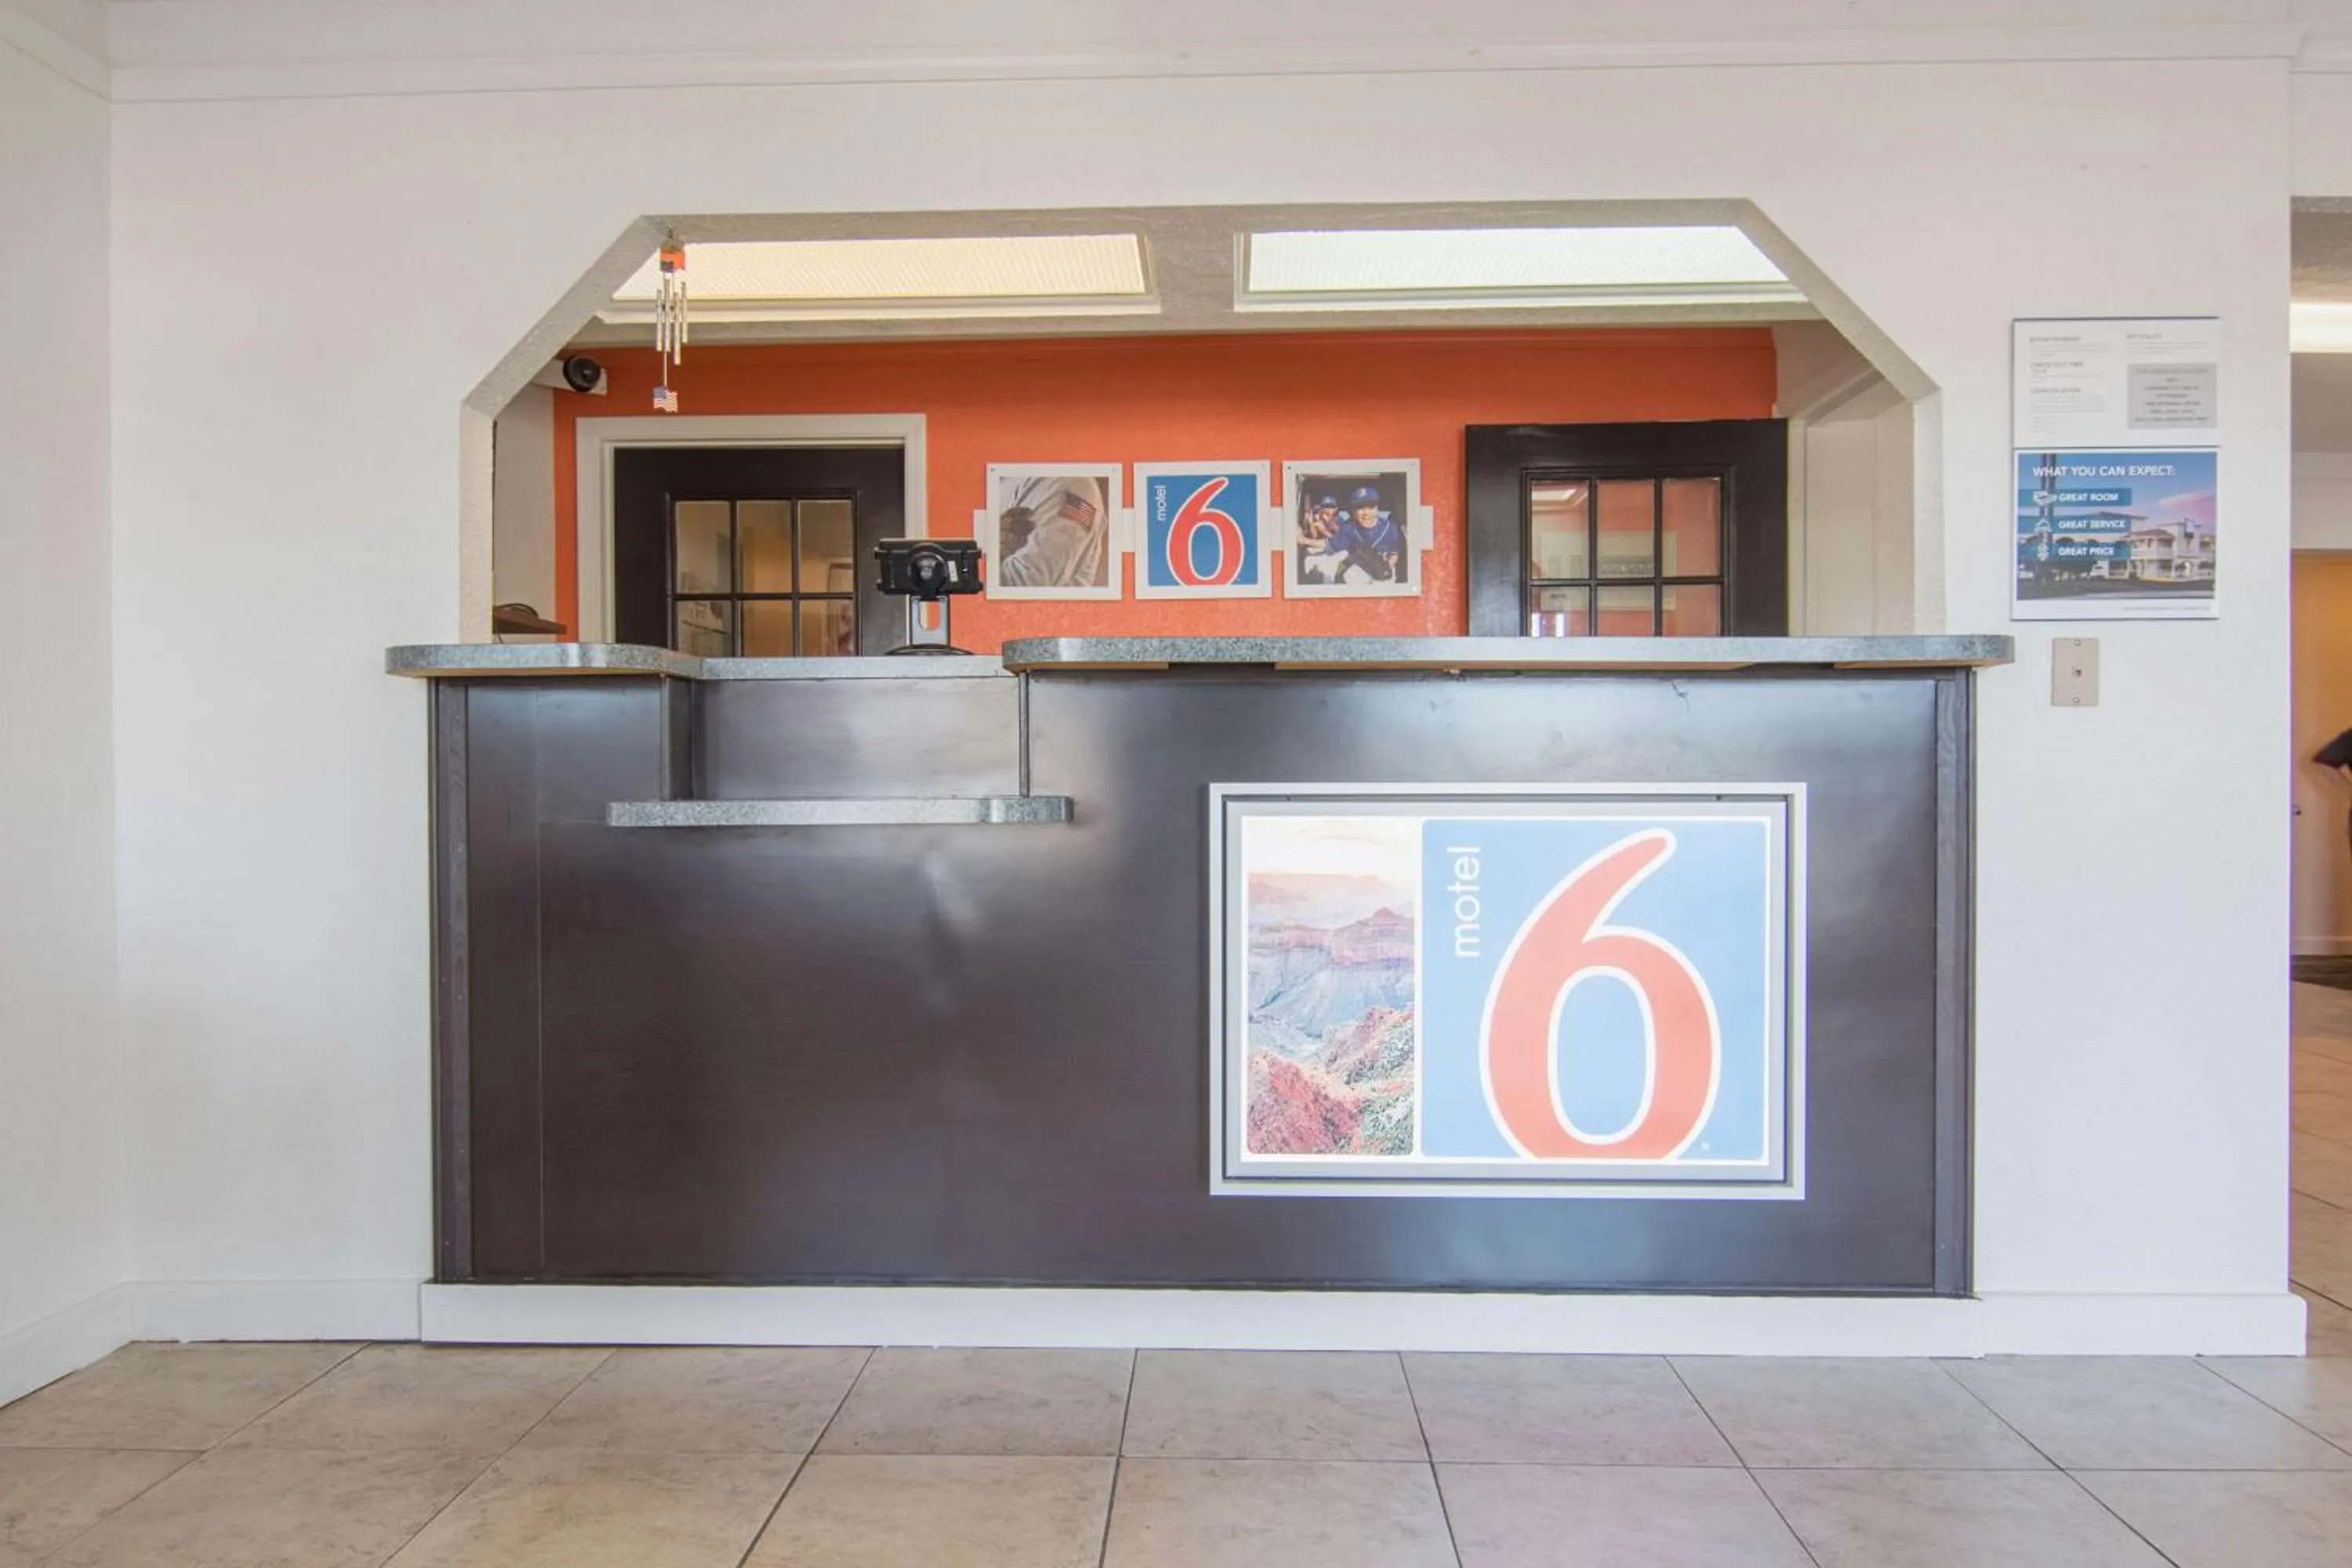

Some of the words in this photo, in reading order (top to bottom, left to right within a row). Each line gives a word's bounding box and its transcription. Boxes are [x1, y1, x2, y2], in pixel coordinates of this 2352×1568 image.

[2033, 466, 2068, 477] WHAT
[2071, 466, 2096, 477] YOU
[2099, 465, 2125, 477] CAN
[2129, 465, 2176, 477] EXPECT:
[1154, 485, 1167, 521] motel
[2058, 492, 2089, 503] GREAT
[2089, 492, 2119, 502] ROOM
[1166, 476, 1245, 586] 6
[2058, 520, 2089, 529] GREAT
[2089, 519, 2126, 528] SERVICE
[2058, 546, 2089, 556] GREAT
[2089, 546, 2115, 556] PRICE
[1447, 846, 1481, 958] motel
[1478, 827, 1722, 1160] 6
